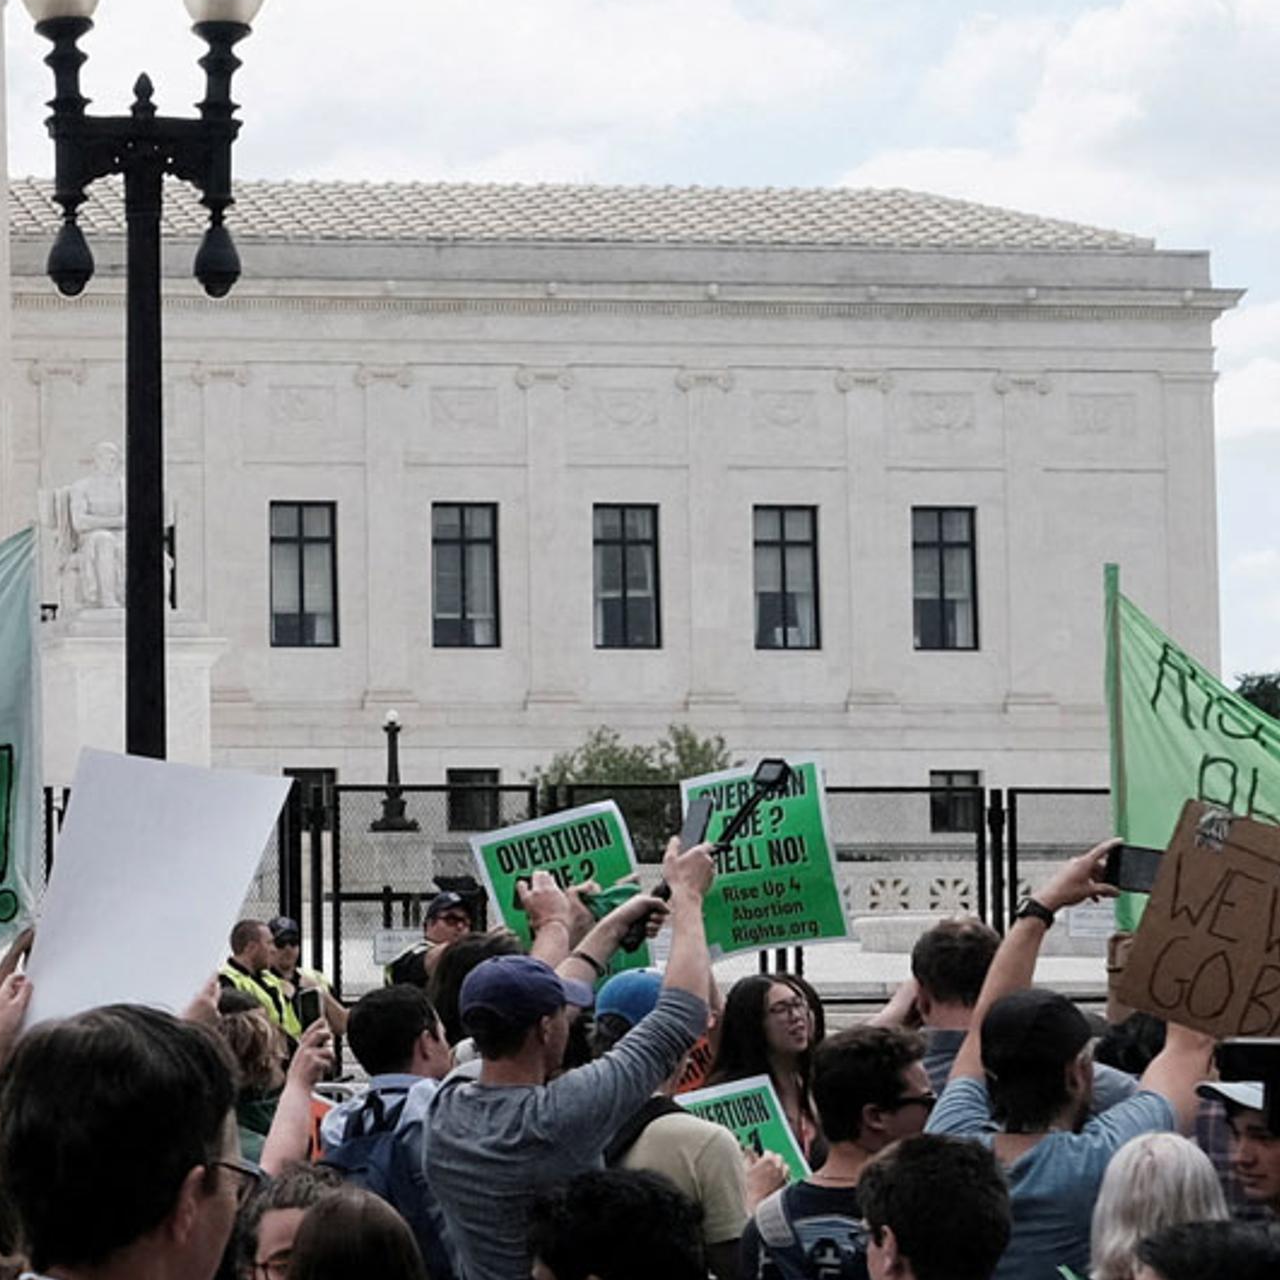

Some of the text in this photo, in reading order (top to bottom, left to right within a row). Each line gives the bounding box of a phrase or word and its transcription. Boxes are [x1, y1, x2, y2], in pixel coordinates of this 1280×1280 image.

[698, 768, 806, 812] VERN
[769, 806, 785, 833] ?
[495, 818, 613, 874] OVERTURN
[767, 834, 809, 867] NO!
[722, 884, 760, 904] Rise
[762, 879, 786, 897] Up
[1170, 852, 1268, 943] WE
[731, 900, 804, 923] Abortion
[1148, 935, 1280, 1037] GO B
[692, 1091, 771, 1130] VERTURN
